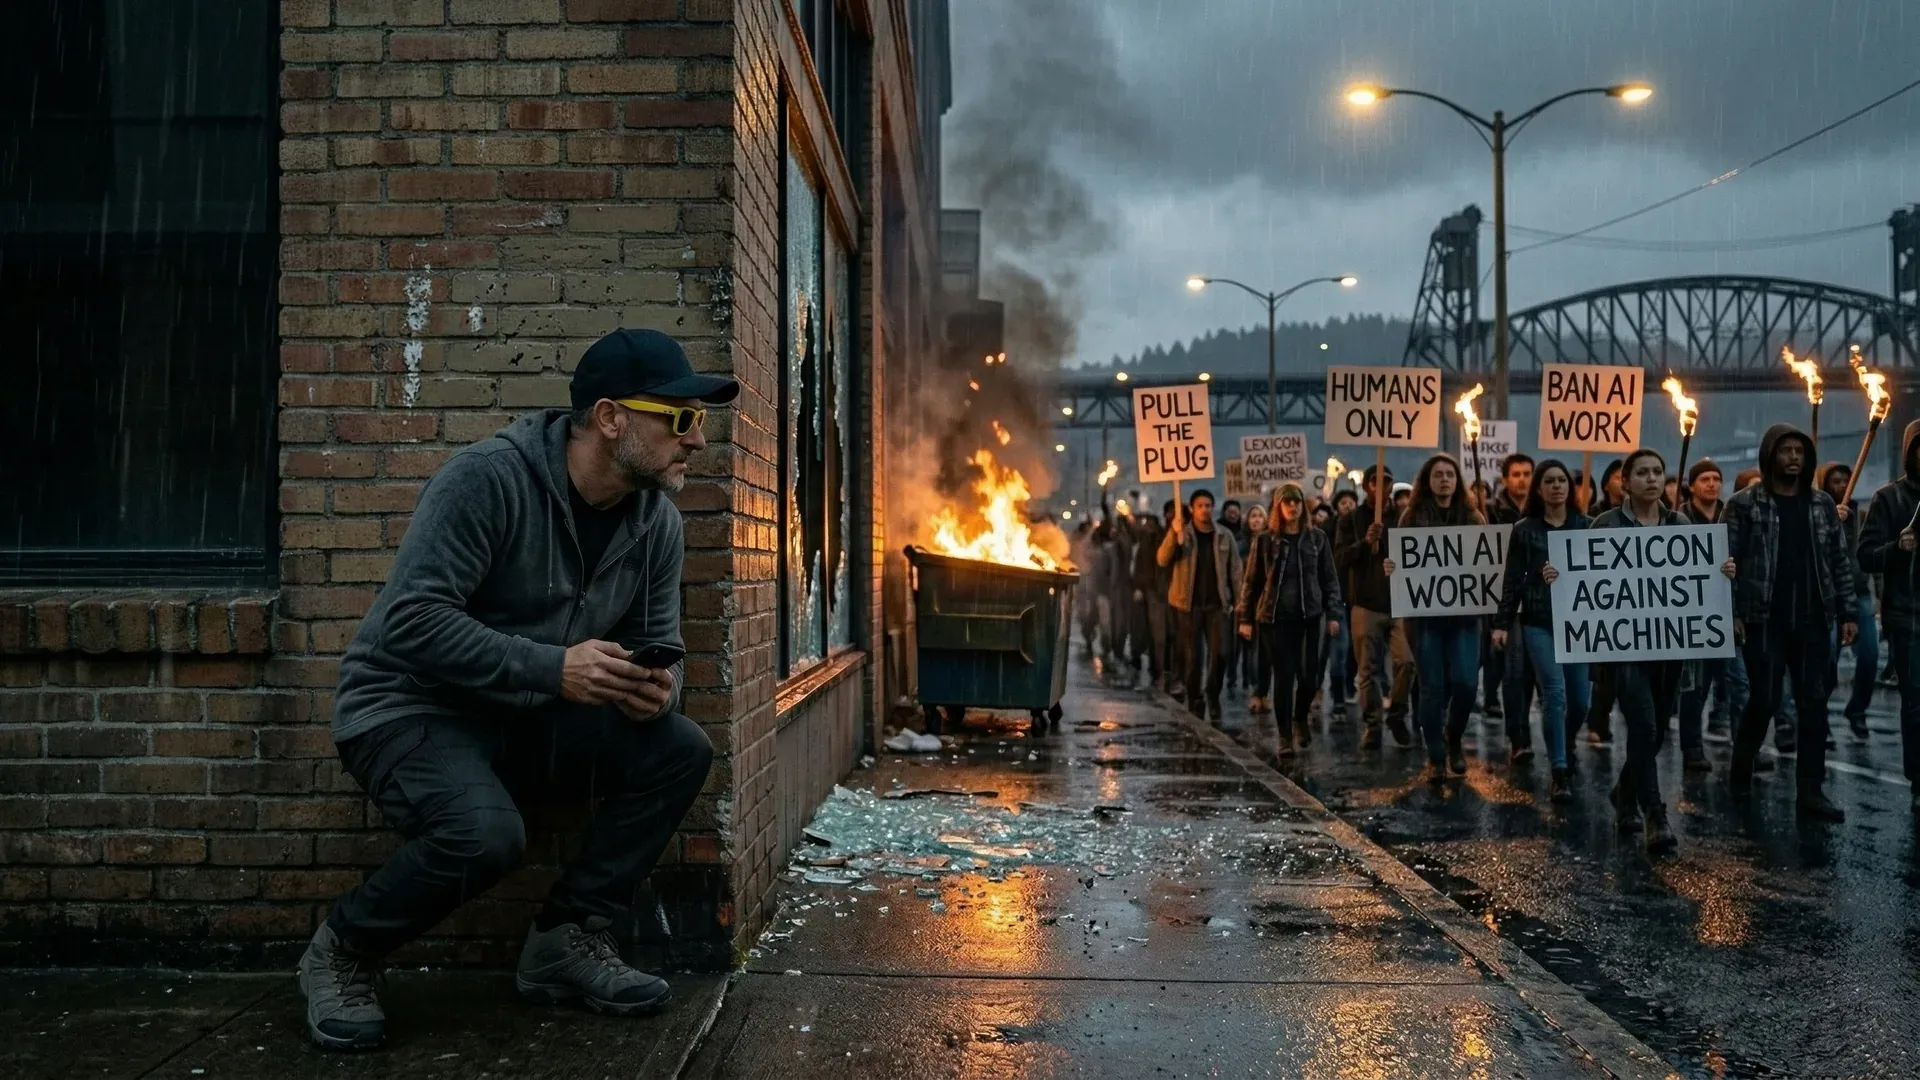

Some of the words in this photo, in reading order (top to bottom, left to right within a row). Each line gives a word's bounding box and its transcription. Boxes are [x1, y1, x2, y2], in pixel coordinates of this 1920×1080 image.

[1331, 372, 1437, 405] HUMANS
[1548, 371, 1600, 404] BAN
[1606, 373, 1635, 405] AI
[1141, 391, 1204, 420] PULL
[1152, 422, 1194, 442] THE
[1345, 408, 1420, 440] ONLY
[1549, 410, 1633, 443] WORK
[1144, 444, 1209, 475] PLUG
[1244, 436, 1301, 452] LEXICON
[1245, 451, 1300, 466] AGAINST
[1246, 466, 1305, 480] MACHINES
[1401, 533, 1464, 569] BAN
[1472, 532, 1503, 566] AI
[1566, 532, 1715, 572] LEXICON
[1405, 572, 1500, 609] WORK
[1572, 574, 1711, 611] AGAINST
[1564, 614, 1726, 653] MACHINES
